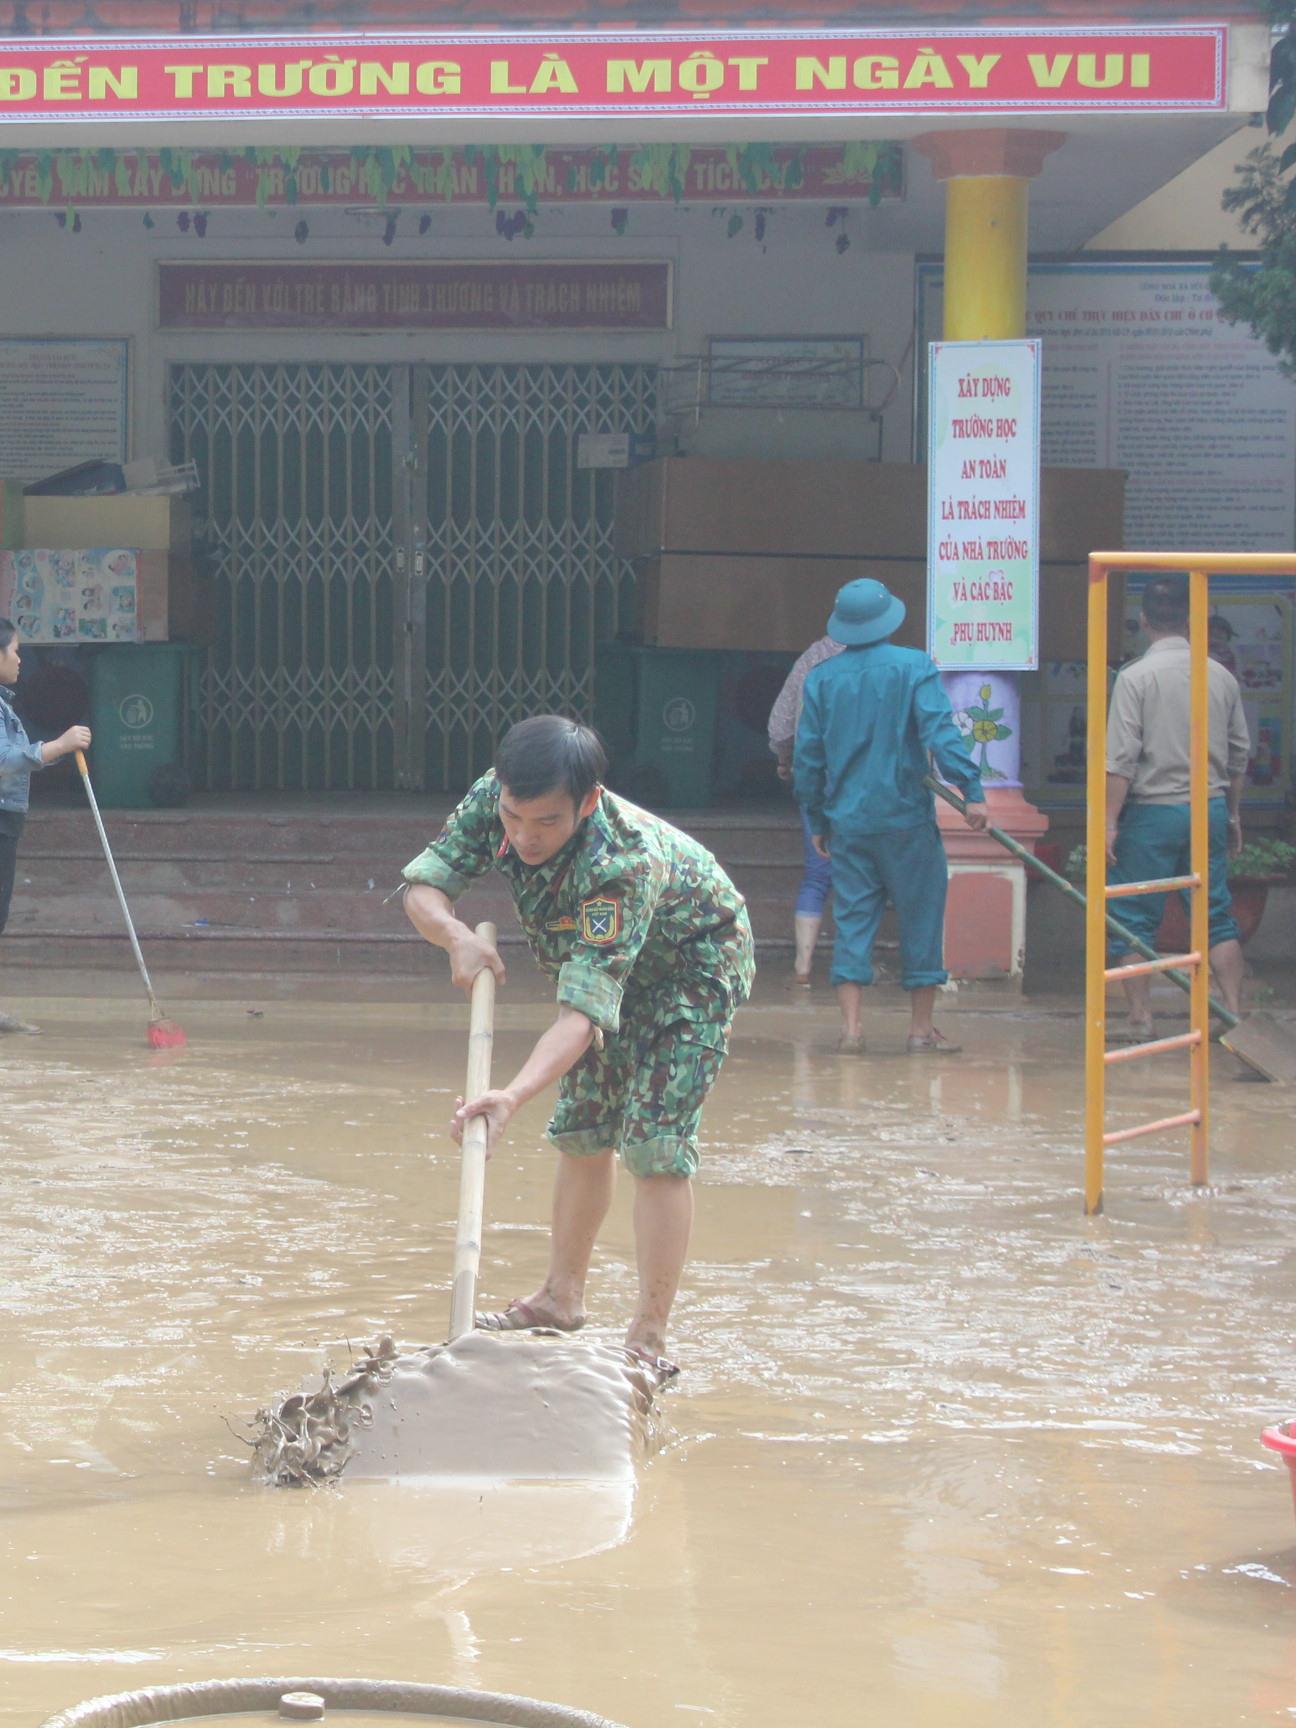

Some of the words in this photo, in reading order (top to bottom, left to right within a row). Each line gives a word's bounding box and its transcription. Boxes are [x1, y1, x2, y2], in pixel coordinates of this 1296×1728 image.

[164, 55, 461, 99] TRƯỜNG
[489, 53, 578, 95] LÀ
[605, 51, 769, 98] MỘT
[794, 47, 1000, 91] NGÀY
[1028, 53, 1151, 90] VUI
[957, 373, 981, 398] XÂY
[981, 374, 1011, 404] DỰNG
[951, 413, 994, 439] TRƯỜNG
[995, 418, 1017, 443] HỌC
[960, 459, 977, 479] AN
[978, 453, 1007, 479] TOÀN
[941, 495, 955, 520] LÀ
[957, 494, 991, 520] TRÁCH
[993, 494, 1026, 525] NHIỆM
[939, 534, 960, 561] CỦA
[962, 536, 984, 561] NHÀ
[987, 535, 1028, 561] TRƯỜNG
[952, 576, 968, 601] VÀ
[969, 577, 991, 601] CÁC
[992, 576, 1013, 606] BẬC
[953, 622, 974, 647] PHỤ
[976, 622, 1013, 642] HUYNH
